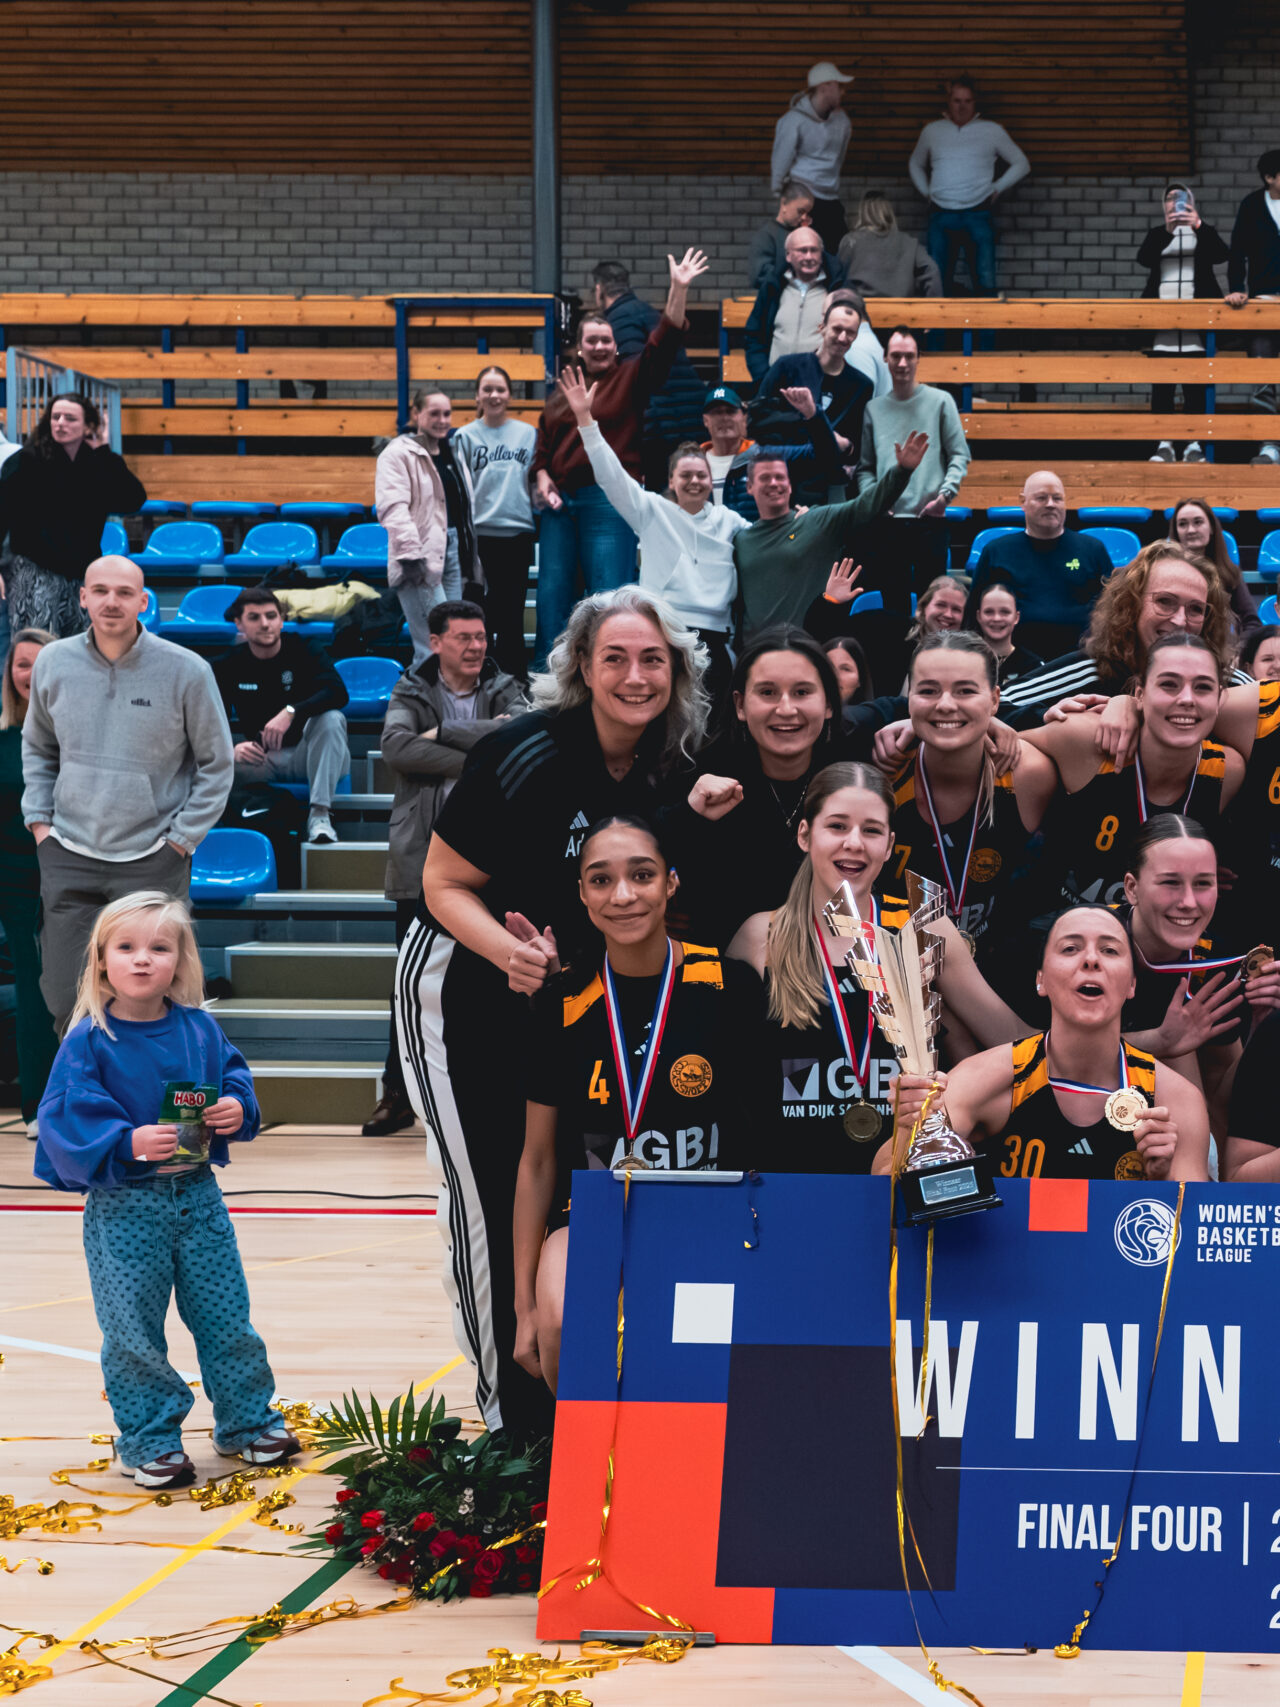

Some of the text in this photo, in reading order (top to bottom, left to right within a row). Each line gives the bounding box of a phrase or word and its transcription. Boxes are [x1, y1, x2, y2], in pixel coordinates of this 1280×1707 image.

[1095, 814, 1119, 852] 8
[894, 844, 912, 879] 7
[588, 1060, 611, 1105] 4
[827, 1057, 900, 1099] GB
[782, 1105, 805, 1118] VAN
[808, 1104, 835, 1119] DIJK
[1000, 1134, 1046, 1179] 30
[1196, 1247, 1252, 1263] LEAGUE
[1016, 1502, 1117, 1551] FINAL
[1130, 1504, 1223, 1553] FOUR
